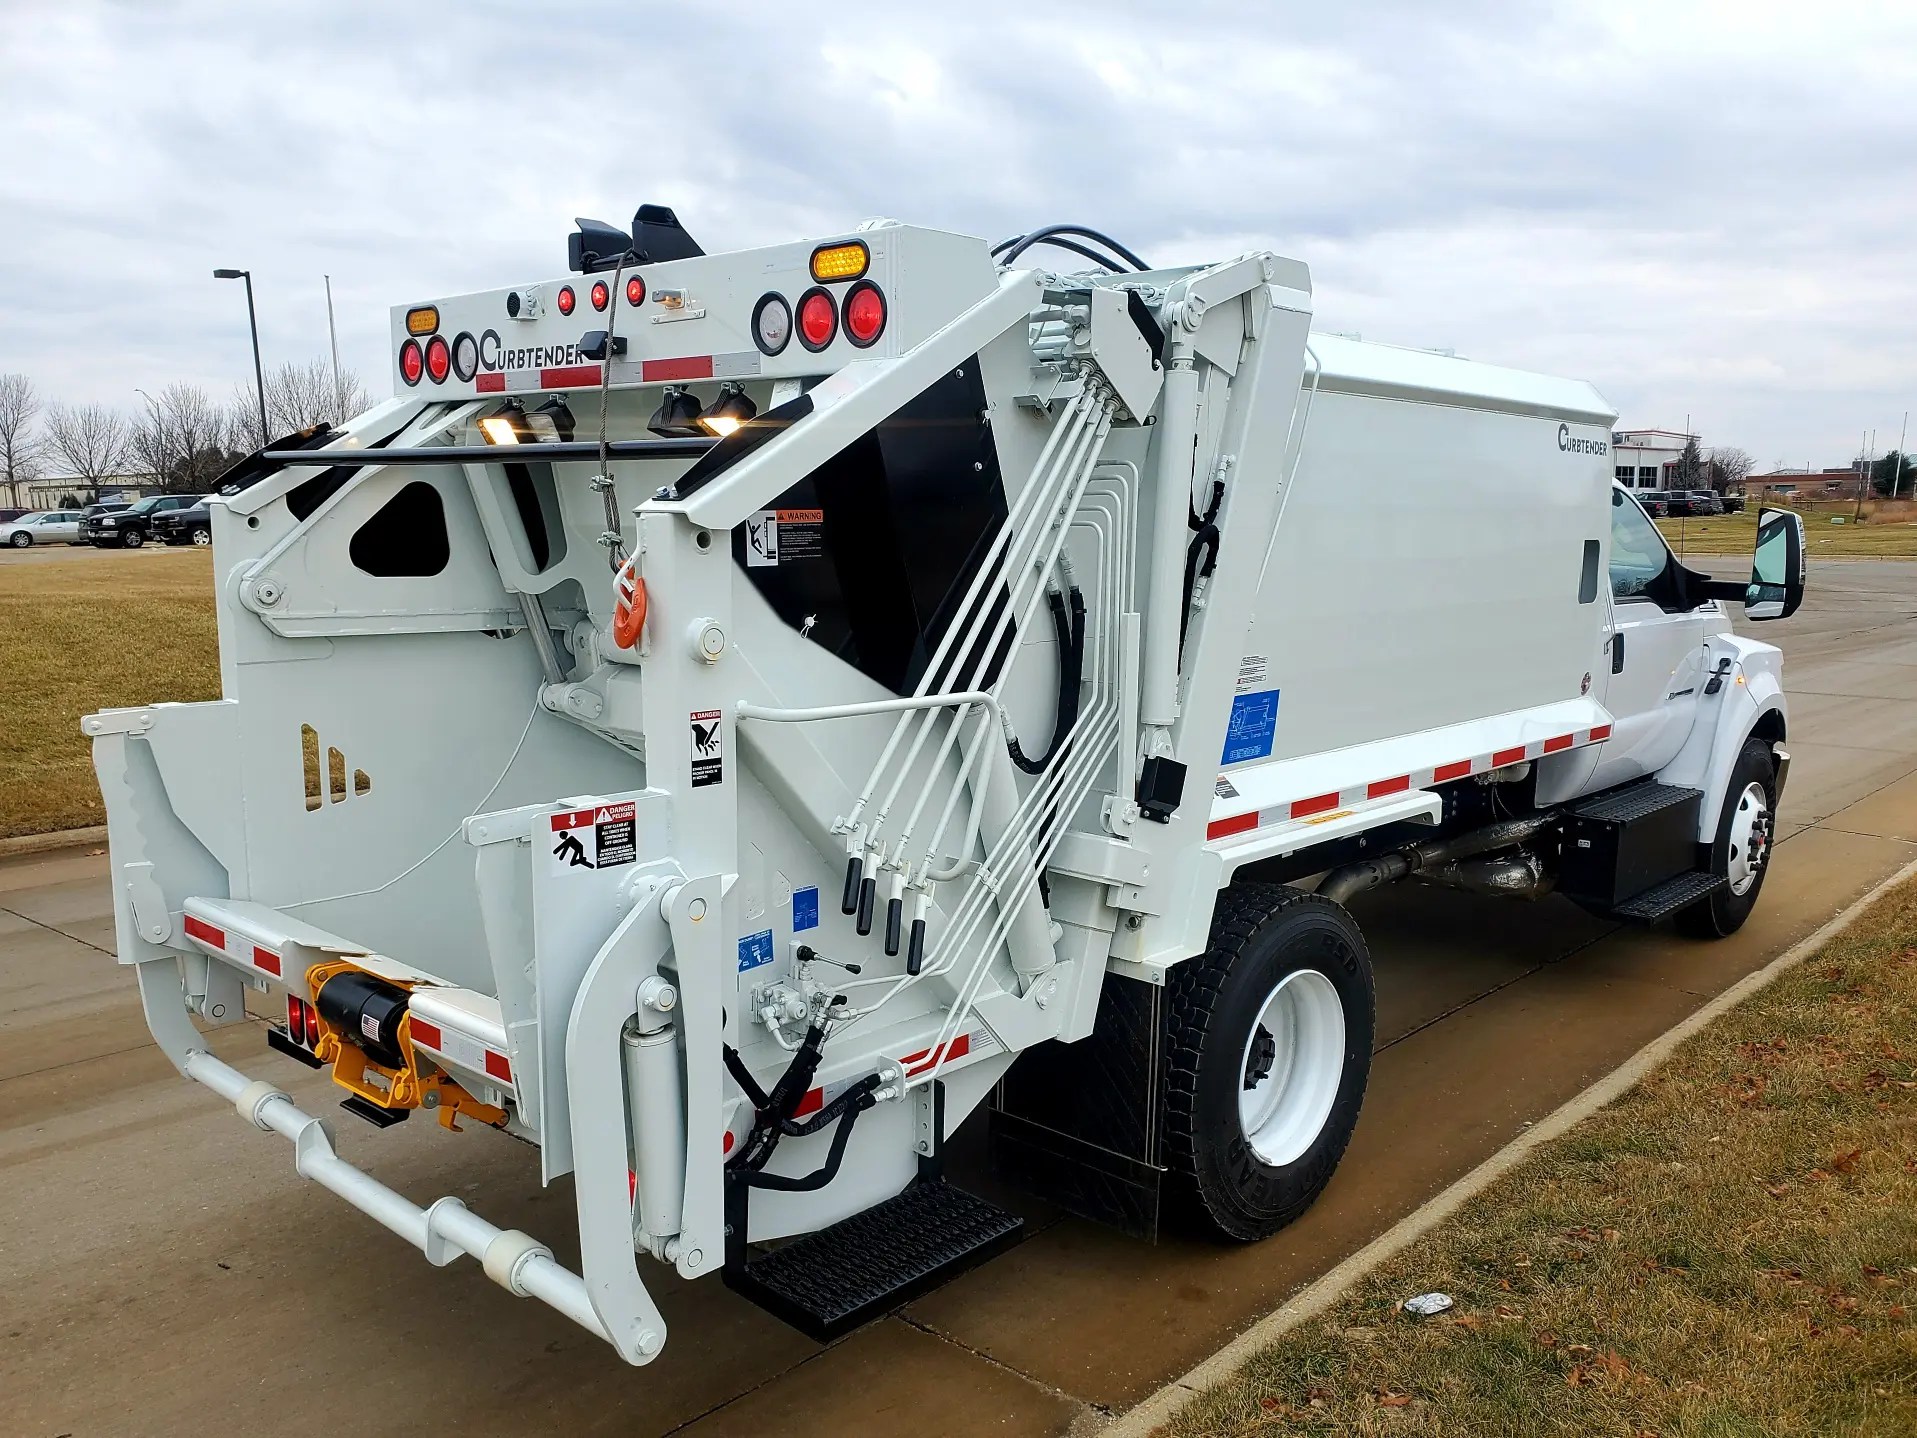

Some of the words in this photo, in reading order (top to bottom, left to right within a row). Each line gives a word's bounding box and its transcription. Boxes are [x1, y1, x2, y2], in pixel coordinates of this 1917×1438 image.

[480, 328, 583, 371] CURBTENDER
[1558, 423, 1607, 457] CURBTENDER
[787, 512, 822, 520] WARNING
[697, 711, 720, 719] DANGER
[610, 804, 635, 814] DANGER
